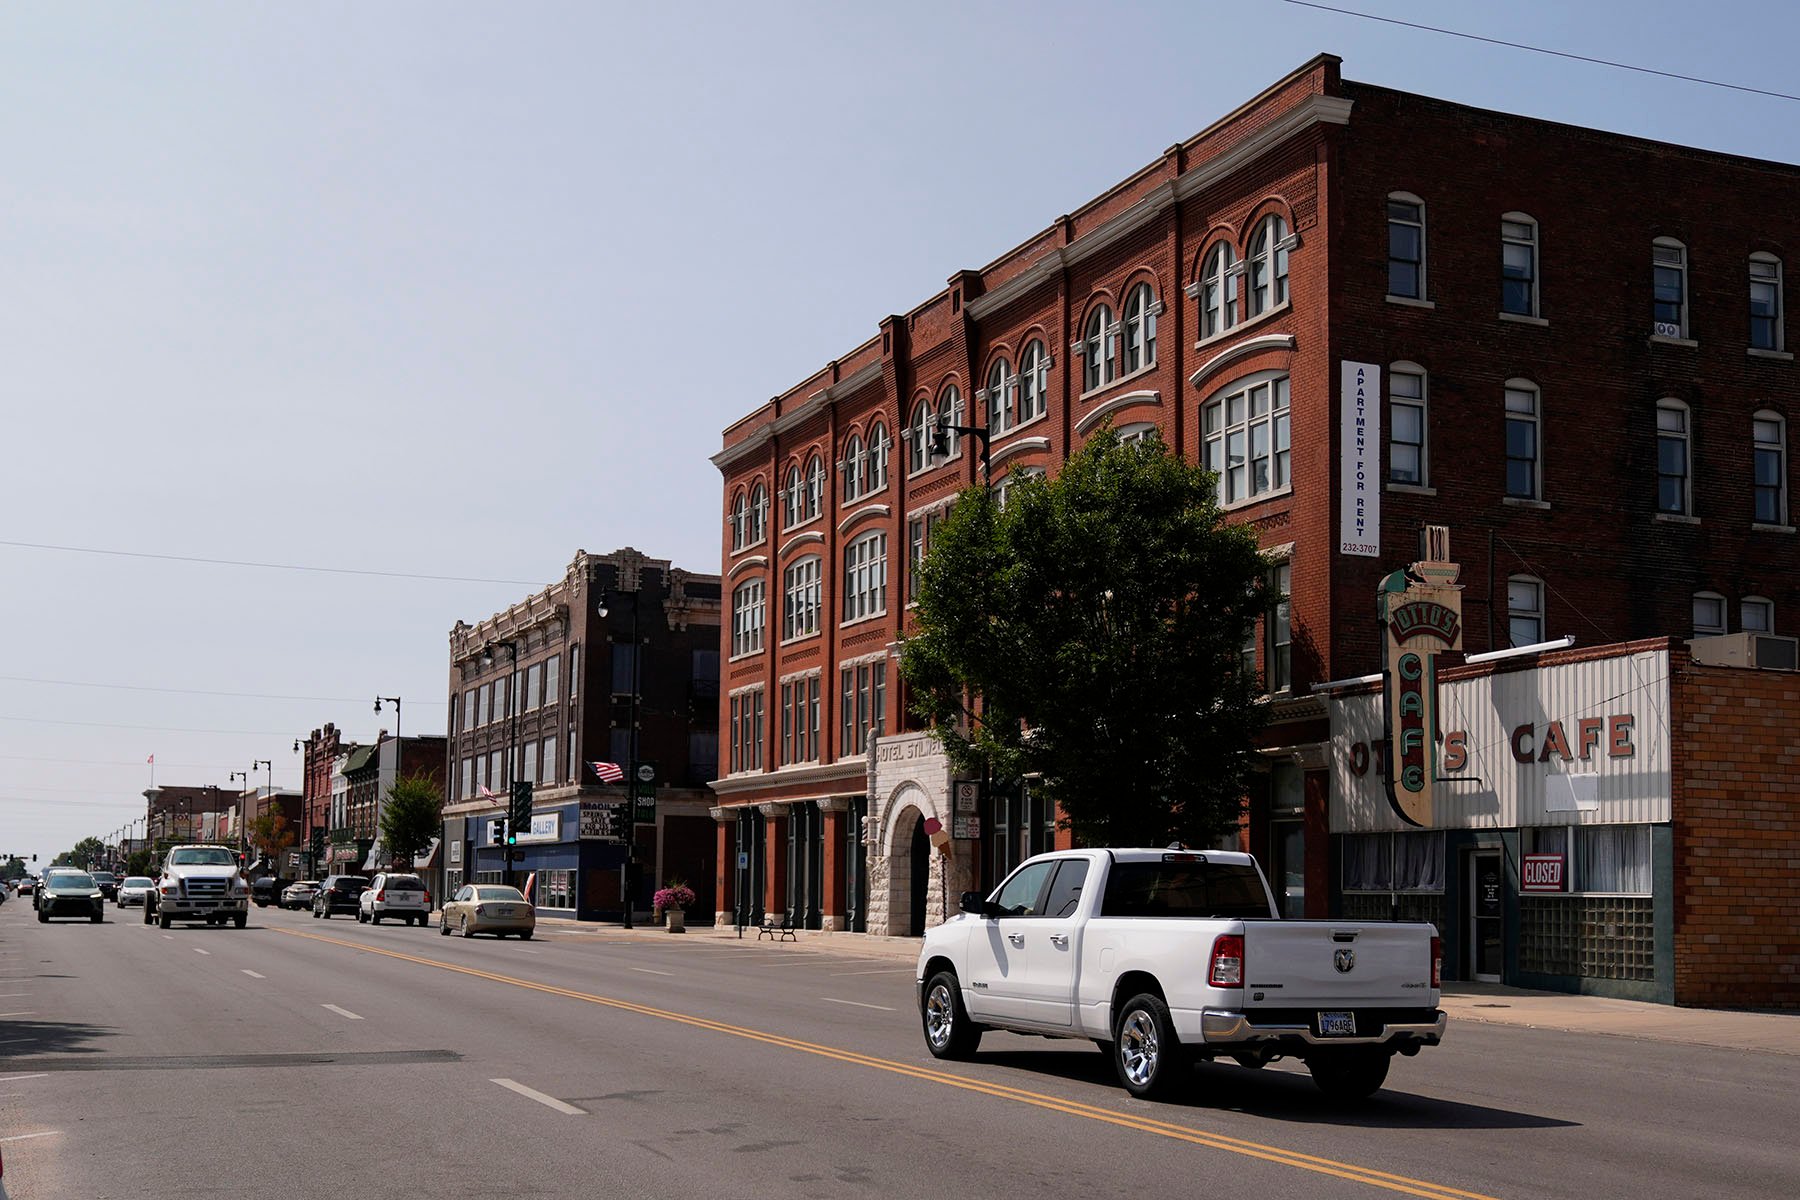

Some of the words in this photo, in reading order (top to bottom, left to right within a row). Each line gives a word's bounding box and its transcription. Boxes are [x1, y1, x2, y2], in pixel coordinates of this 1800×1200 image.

[1356, 368, 1365, 456] APARTMENT
[1356, 461, 1365, 491] FOR
[1356, 498, 1365, 537] RENT
[1343, 542, 1377, 554] 232-3707
[1398, 604, 1456, 632] OTTO'S
[1398, 653, 1425, 793] CAFE
[1511, 714, 1634, 764] CAFE
[876, 744, 904, 763] HOTEL
[637, 796, 655, 807] SHOP
[533, 820, 555, 835] GALLERY
[1525, 862, 1561, 883] CLOSED
